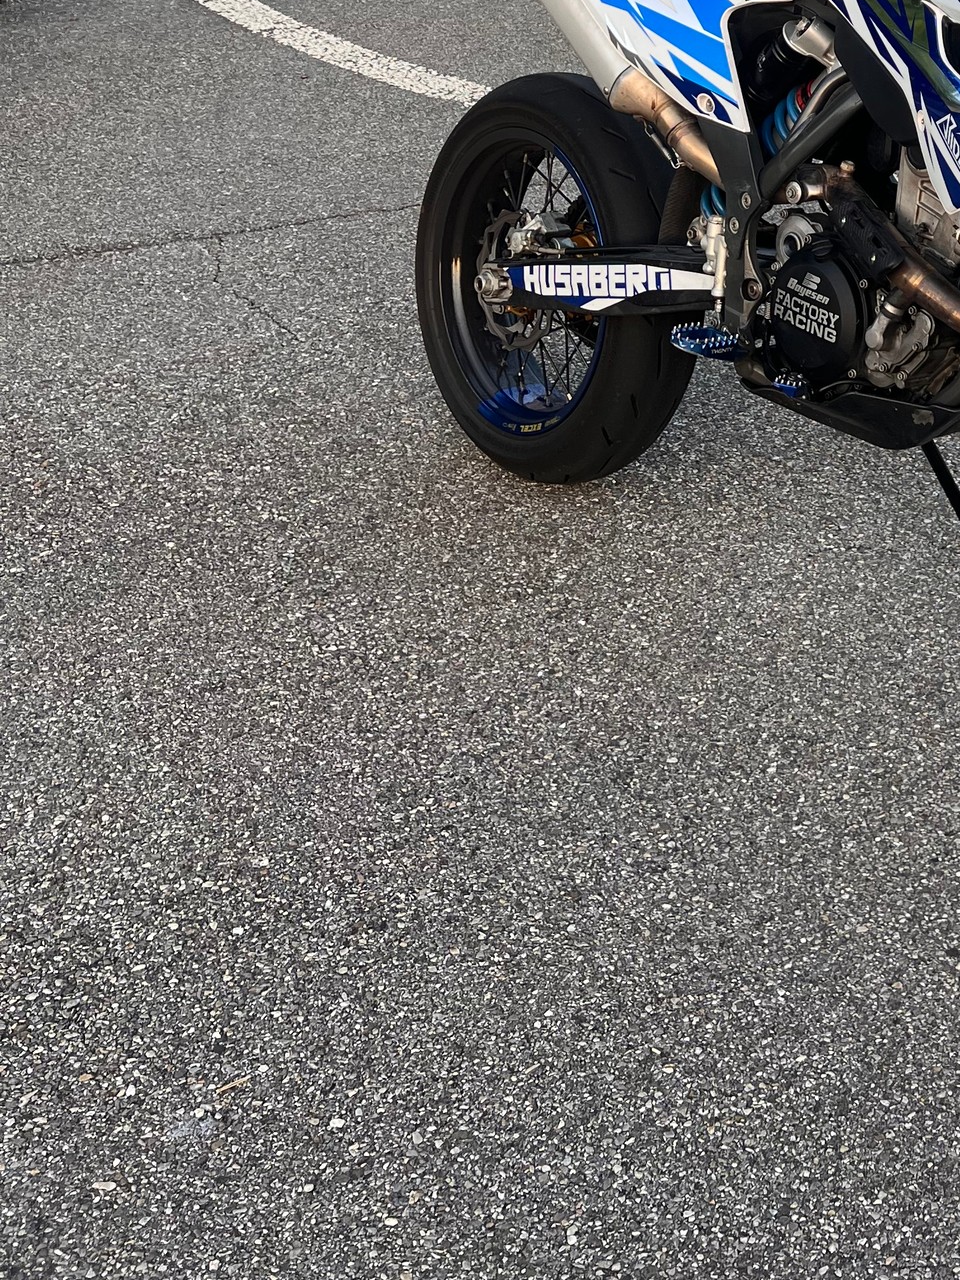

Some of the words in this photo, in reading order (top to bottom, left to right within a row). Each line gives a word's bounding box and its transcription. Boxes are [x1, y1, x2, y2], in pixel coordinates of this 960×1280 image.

[775, 288, 840, 329] FACTORY
[787, 277, 830, 305] Boyesen
[774, 303, 837, 343] RACING
